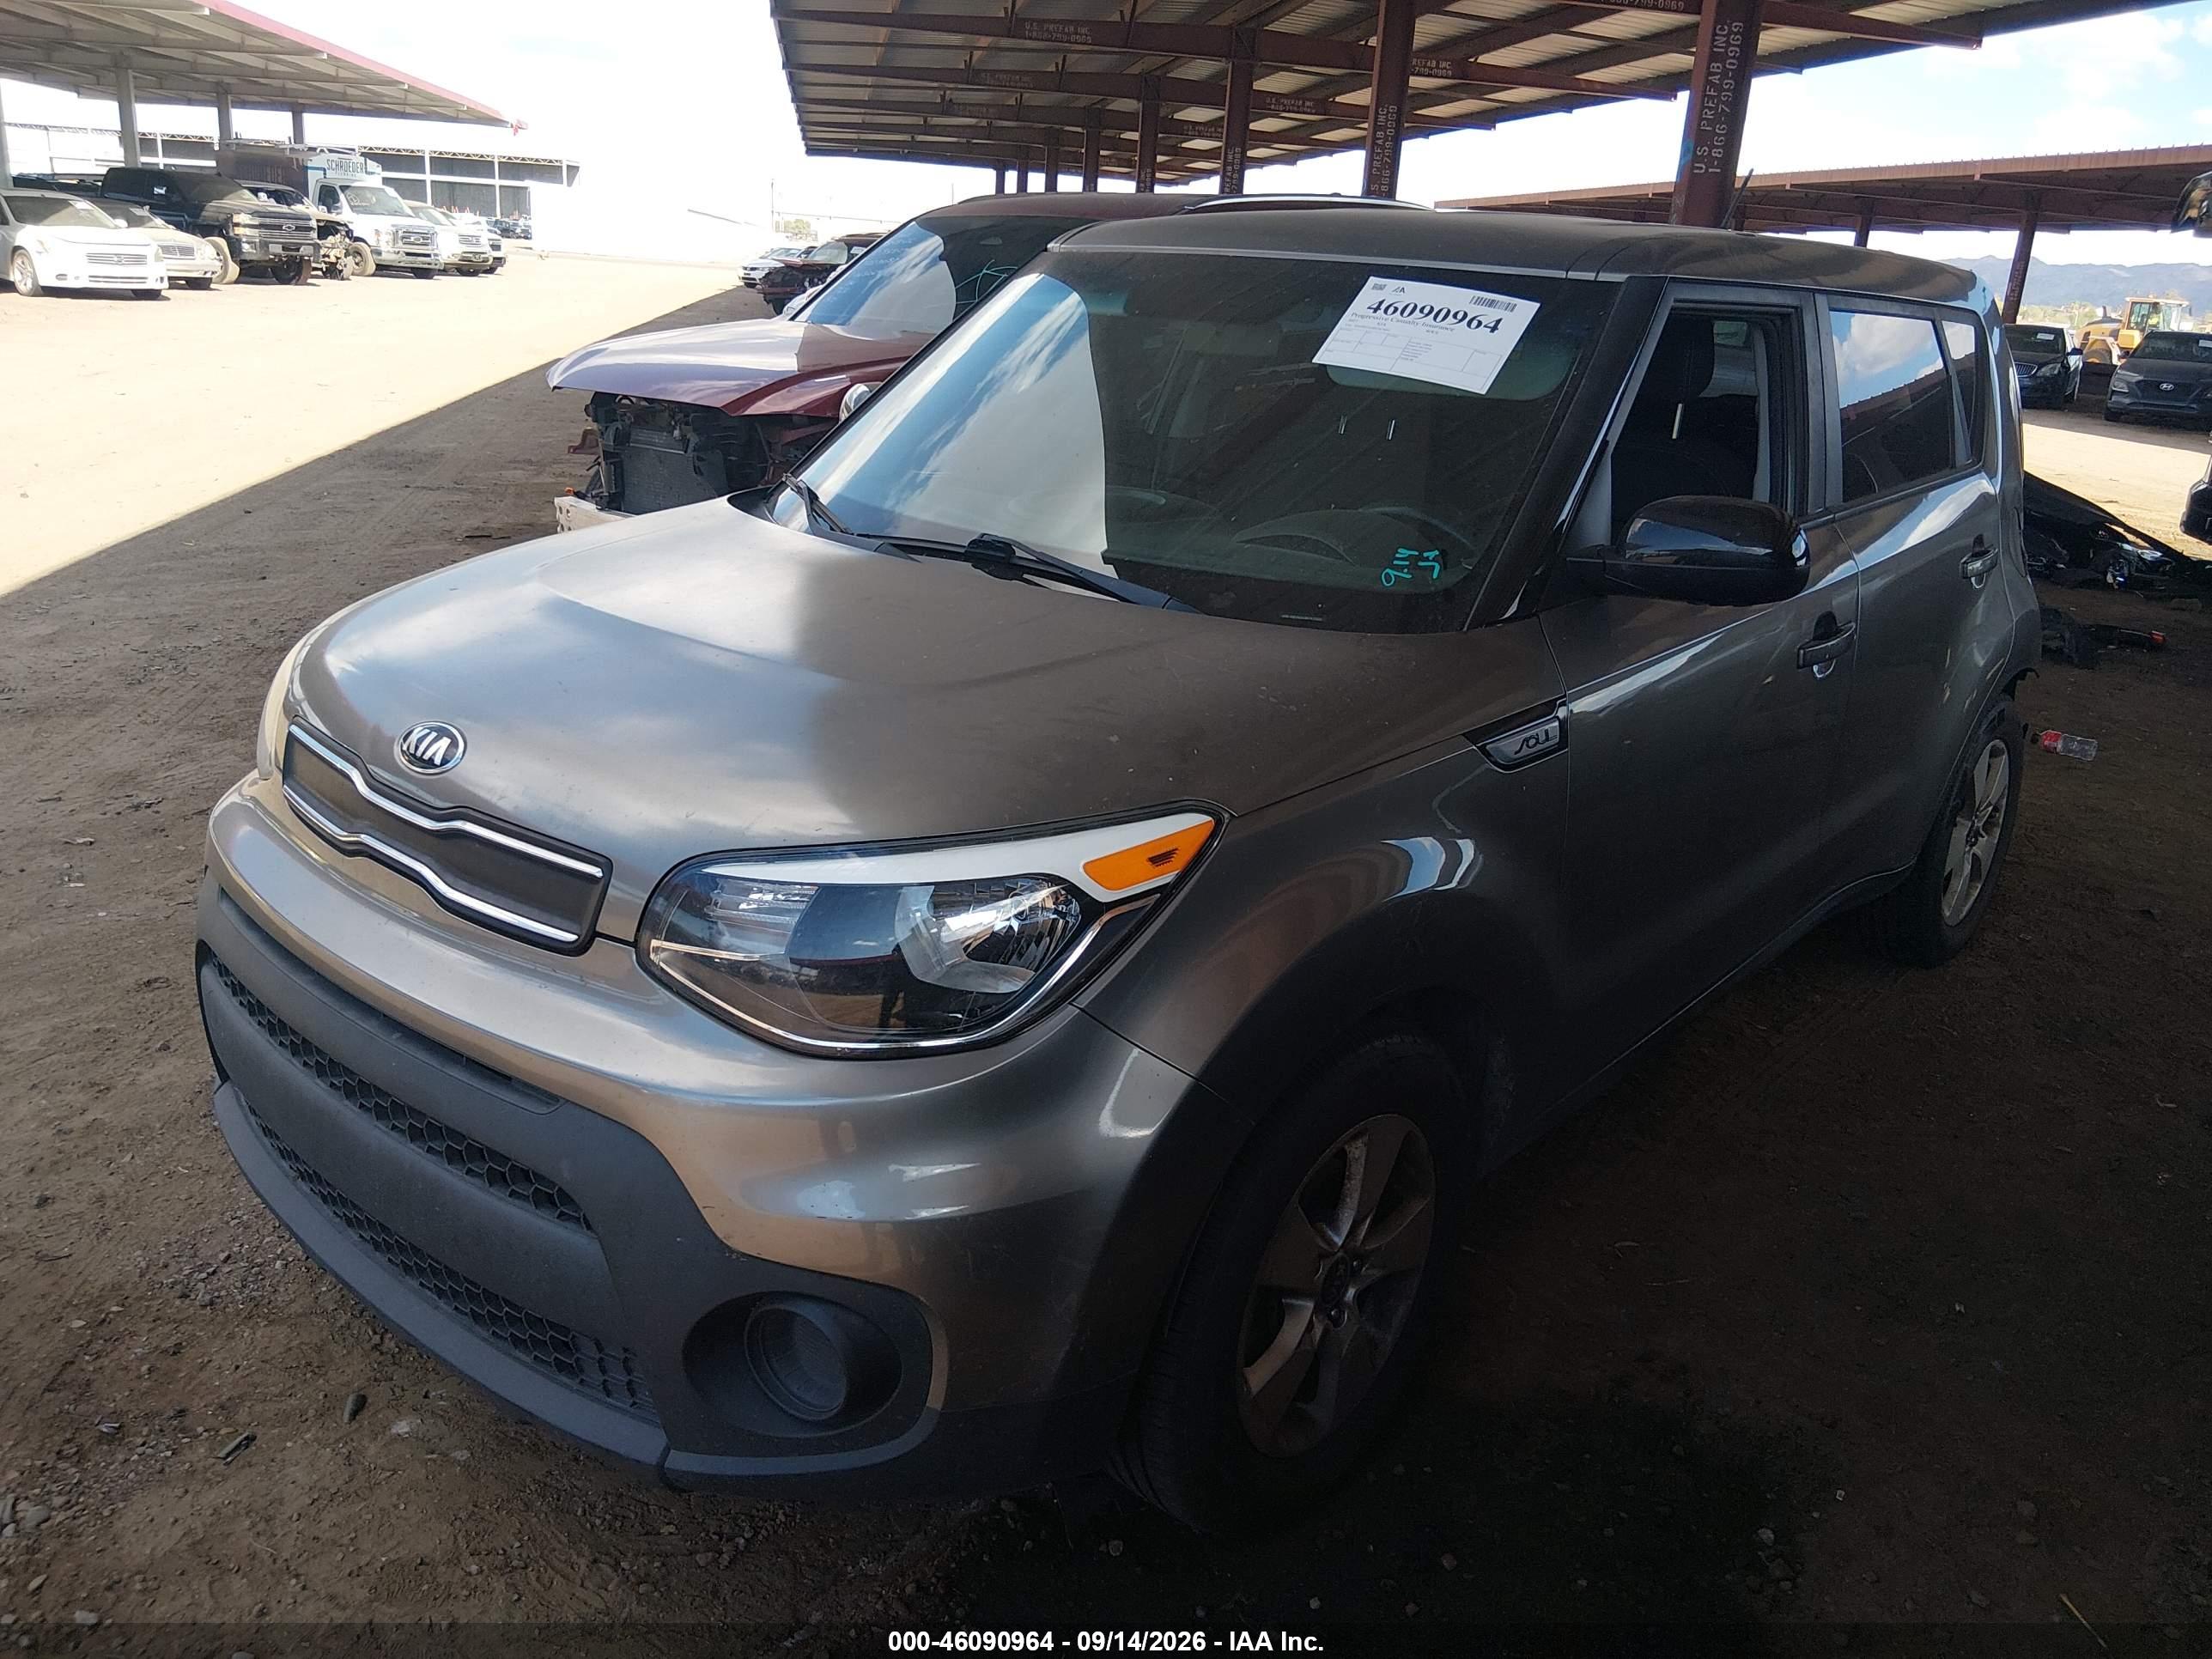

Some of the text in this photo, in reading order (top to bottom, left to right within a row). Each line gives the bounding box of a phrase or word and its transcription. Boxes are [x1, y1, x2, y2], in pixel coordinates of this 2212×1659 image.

[1693, 21, 1730, 173] U.S. PREFAB INC.
[1708, 21, 1744, 173] 1-866-799-0969
[326, 158, 364, 174] SCHROEDER
[1372, 131, 1385, 175] PREFAB
[1380, 105, 1398, 198] -866-799-0969
[1351, 312, 1389, 322] Progressive
[1390, 317, 1419, 326] Casualty
[1421, 322, 1456, 332] Insurance
[1366, 298, 1504, 334] 46090964
[402, 726, 453, 766] KIA
